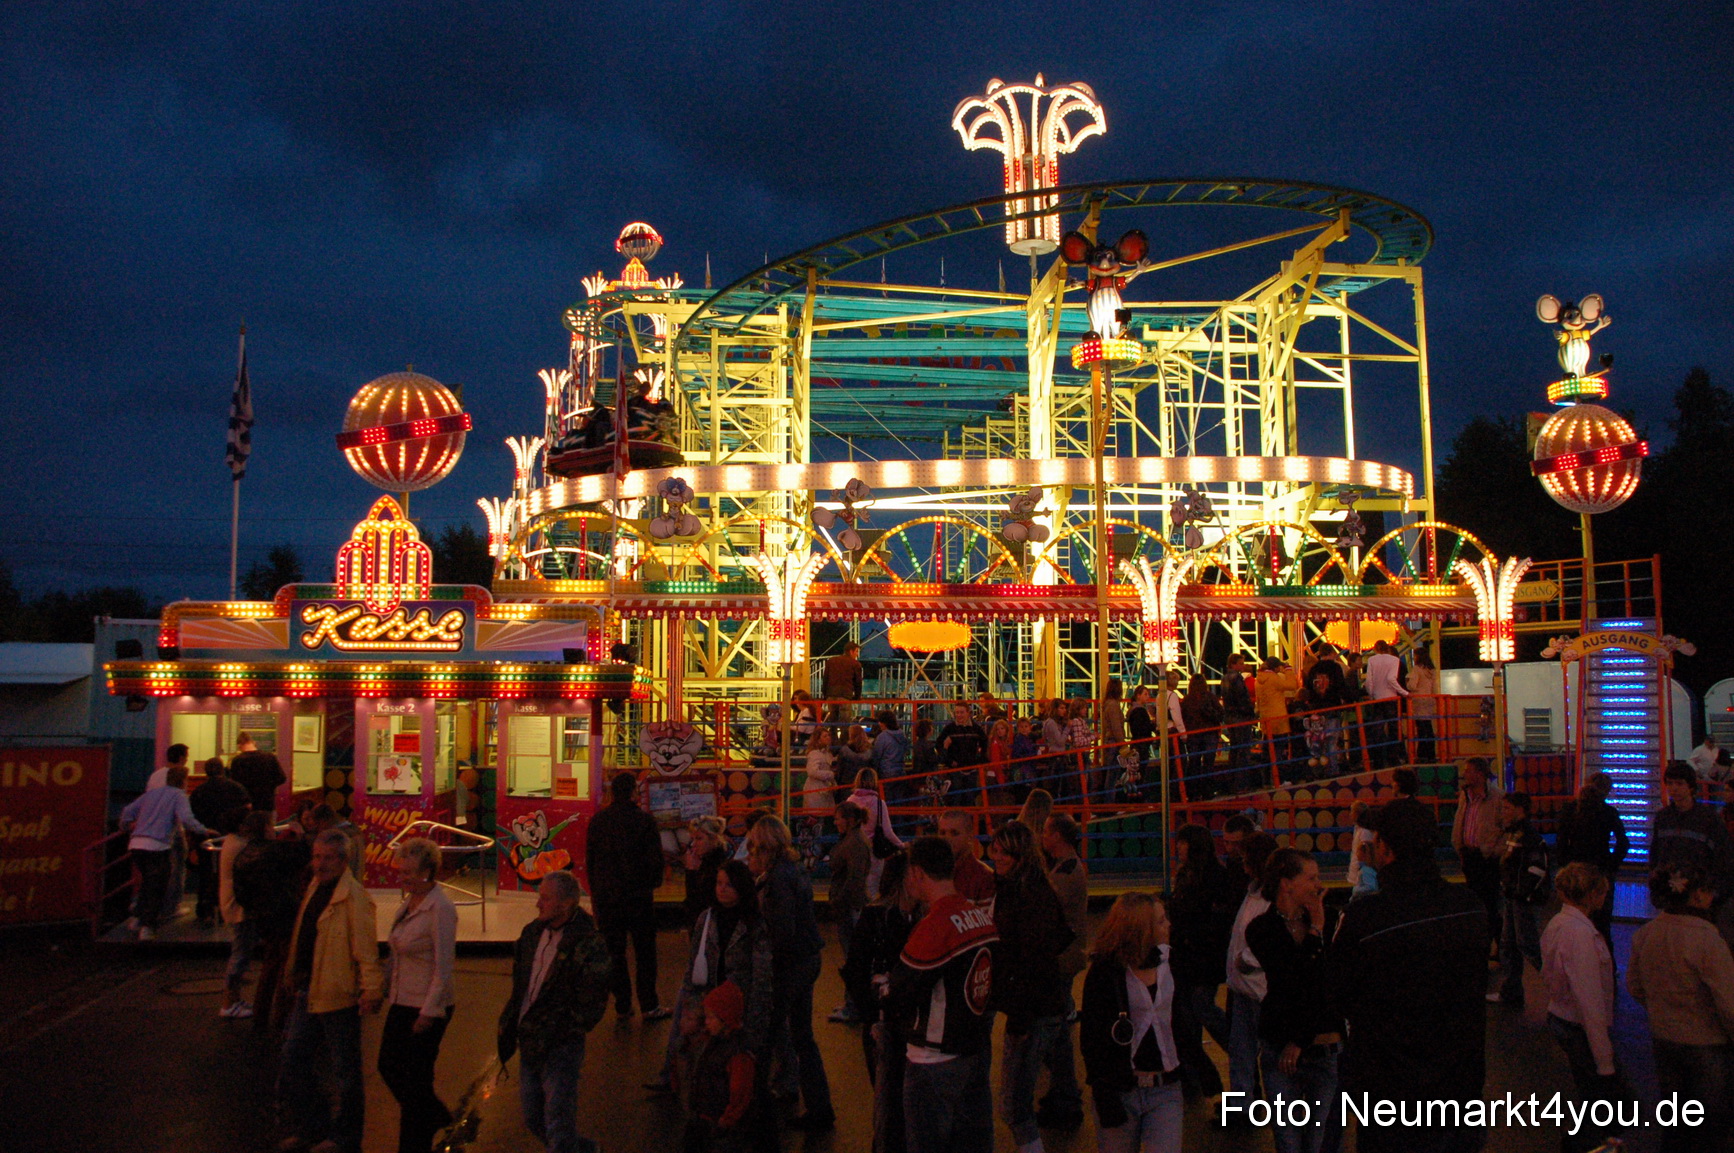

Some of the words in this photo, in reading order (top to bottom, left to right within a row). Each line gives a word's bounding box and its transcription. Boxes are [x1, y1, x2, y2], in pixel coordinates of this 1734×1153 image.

[1513, 583, 1553, 598] USGANG
[302, 606, 465, 650] Kasse
[1582, 634, 1649, 649] AUSGANG
[231, 701, 262, 712] Kasse
[266, 701, 272, 711] 1
[377, 703, 405, 712] Kasse
[408, 703, 415, 712] 2
[515, 704, 537, 713] Kasse
[364, 805, 424, 834] WILDE
